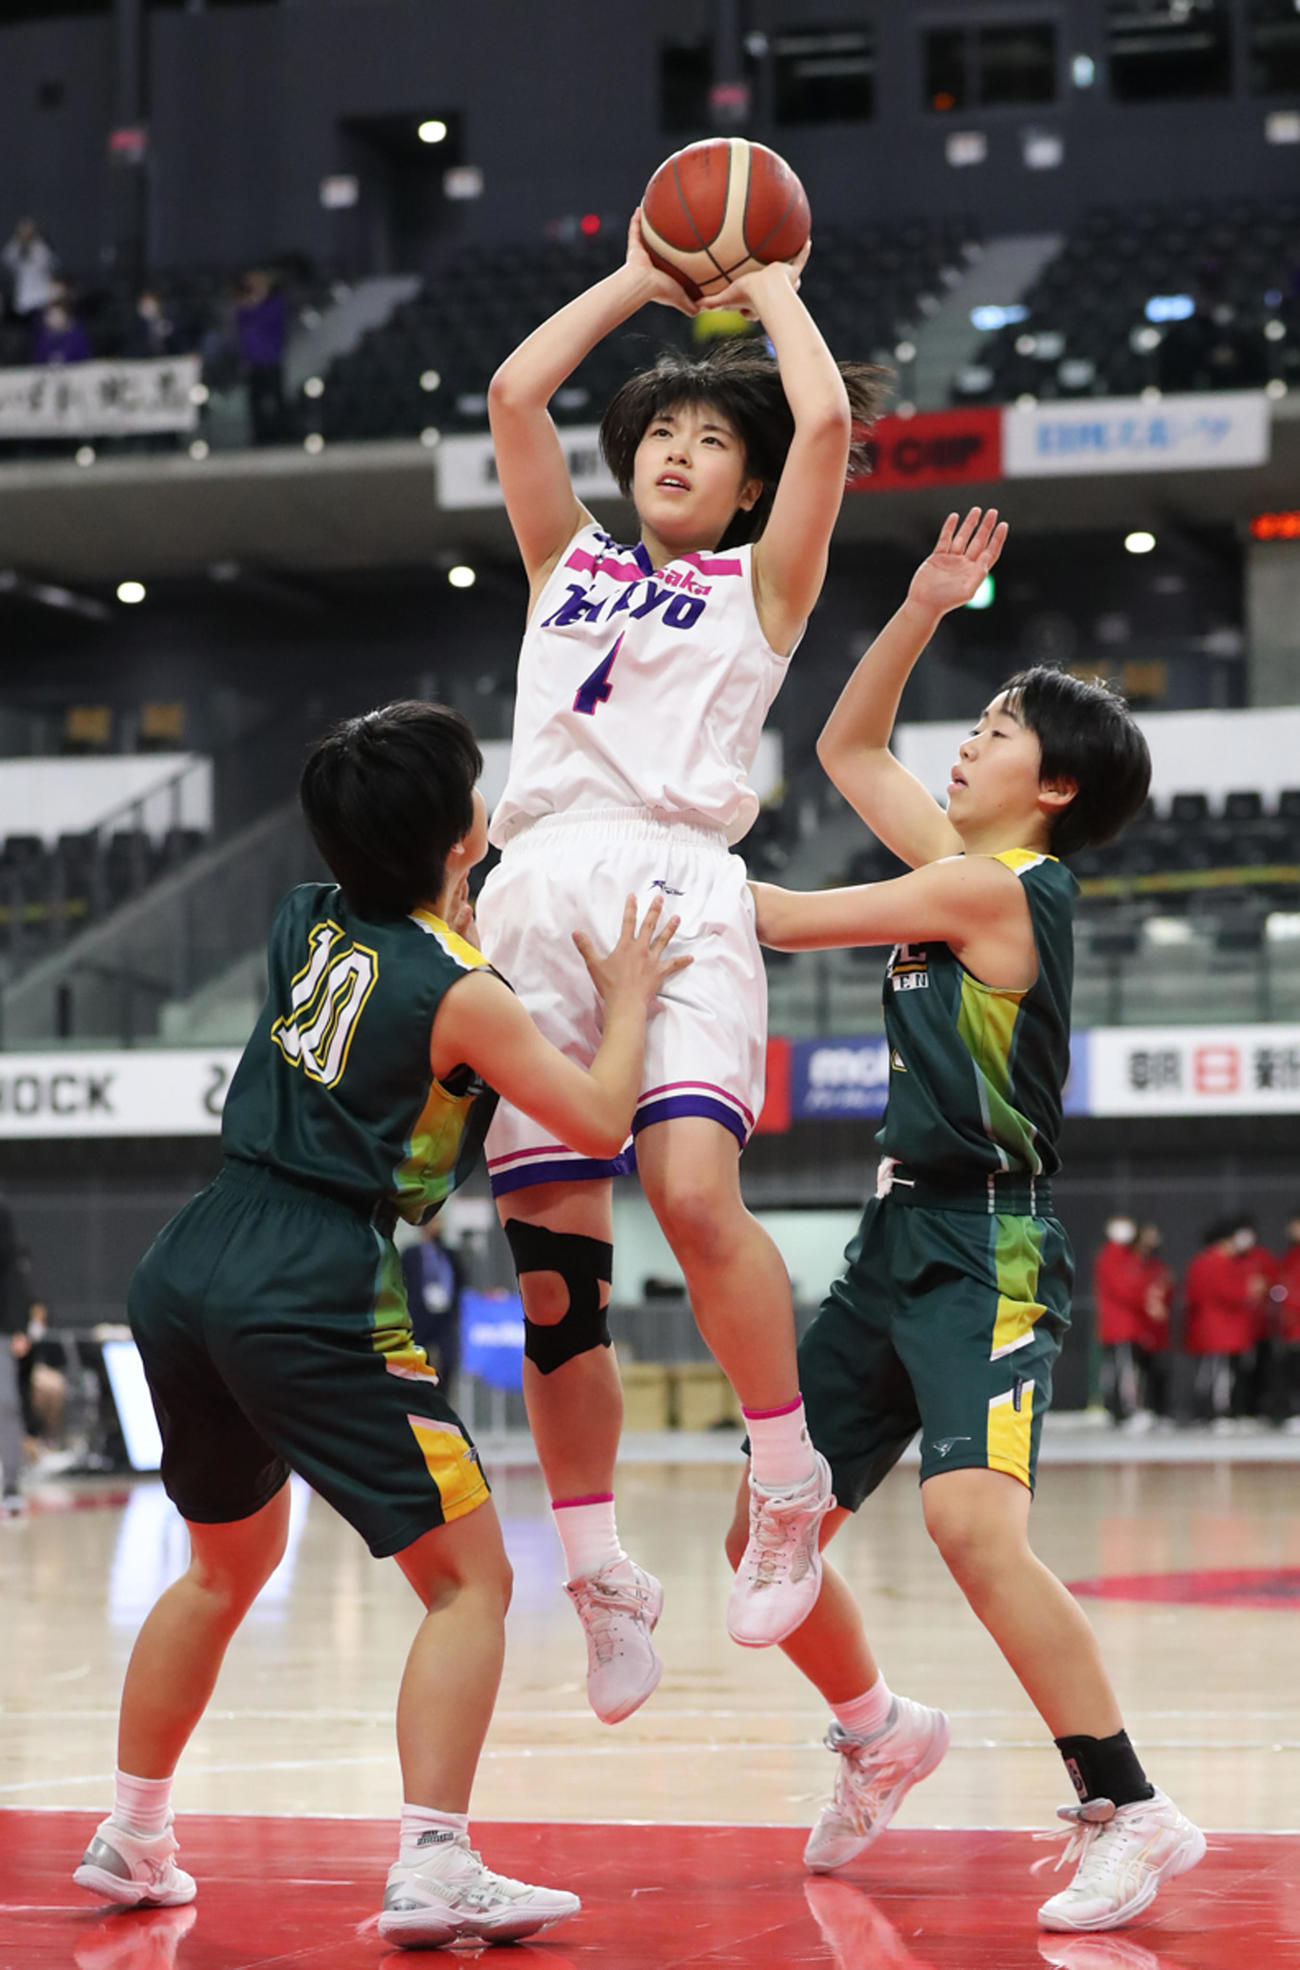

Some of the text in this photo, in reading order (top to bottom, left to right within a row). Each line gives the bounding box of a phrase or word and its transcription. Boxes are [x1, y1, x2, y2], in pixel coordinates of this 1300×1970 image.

[651, 567, 713, 596] saka
[572, 629, 626, 716] 4
[270, 917, 379, 1090] 10
[0, 1073, 117, 1115] OCK
